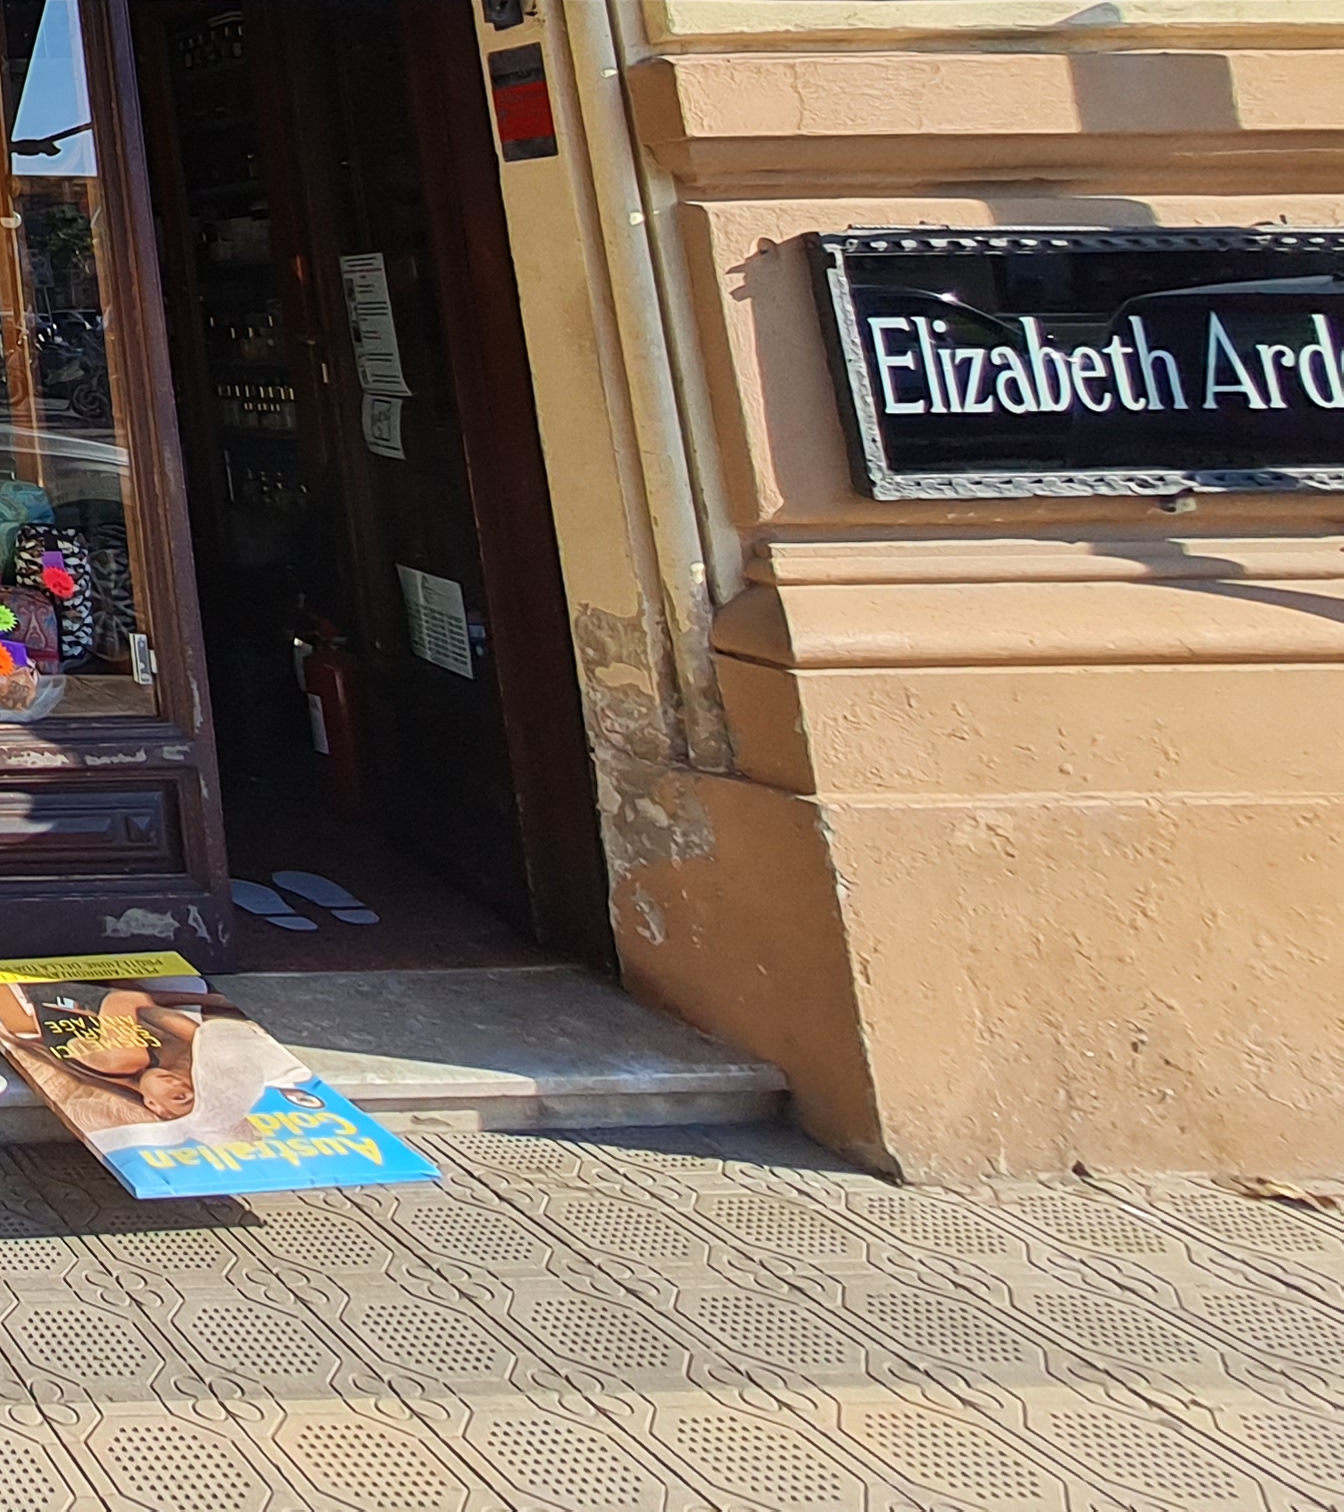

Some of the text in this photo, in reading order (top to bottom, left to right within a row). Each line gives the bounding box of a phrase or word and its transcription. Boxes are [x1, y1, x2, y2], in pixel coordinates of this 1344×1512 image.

[867, 310, 1344, 414] Elizabeth Ard
[43, 1017, 85, 1035] AGE
[71, 1024, 151, 1043] SOLARI
[49, 1034, 161, 1060] COSMETICI
[245, 1111, 358, 1137] Gold
[139, 1136, 383, 1172] Australian
